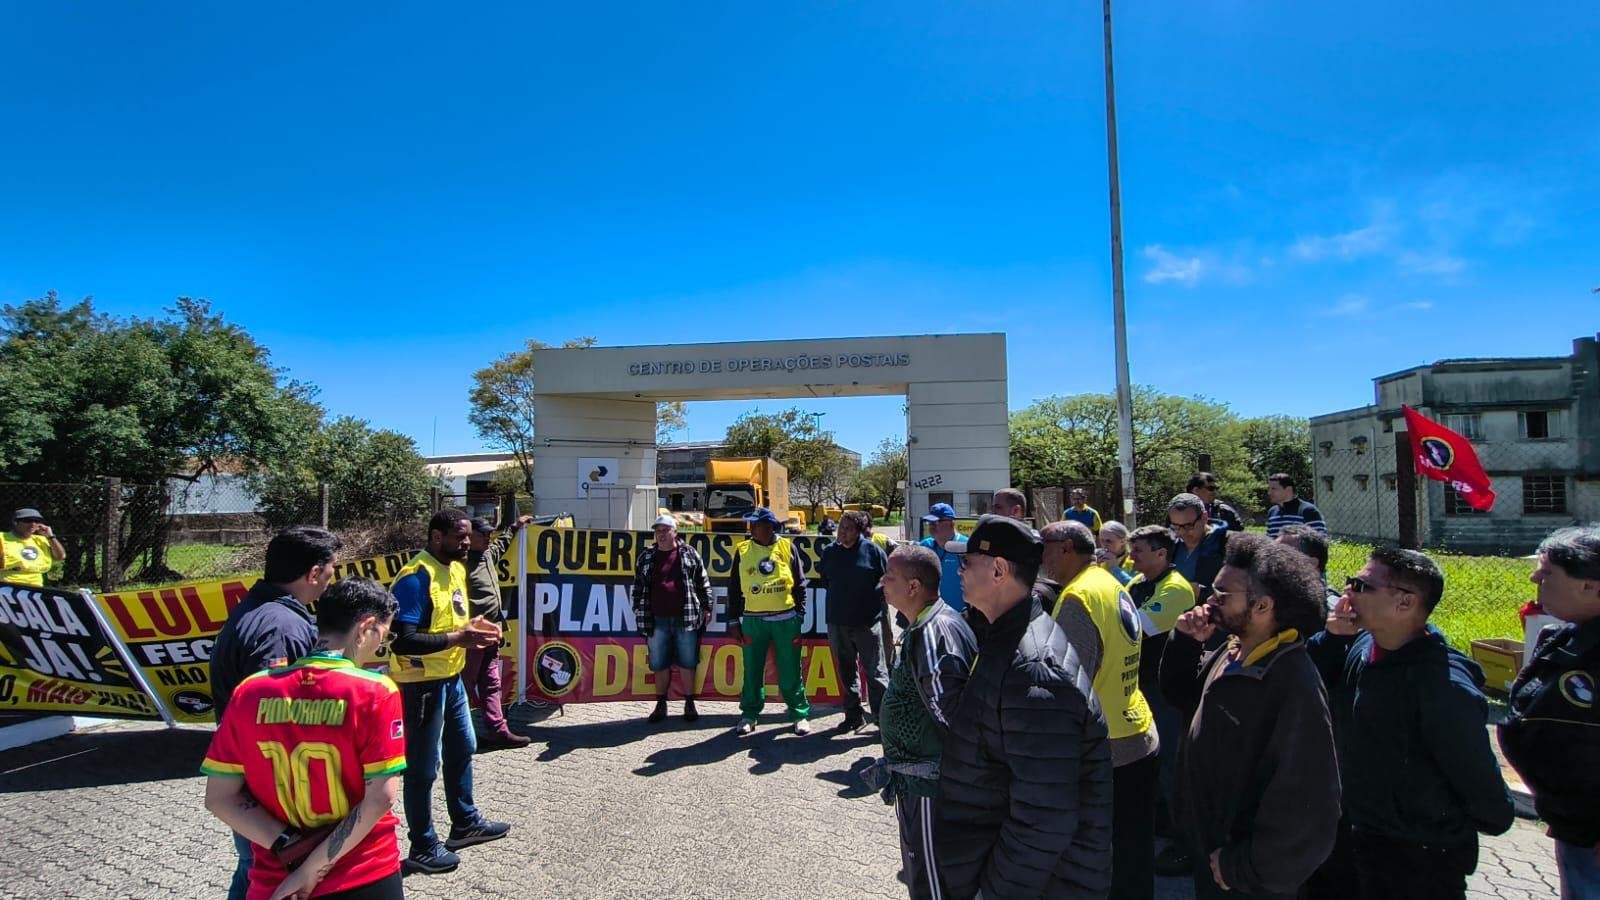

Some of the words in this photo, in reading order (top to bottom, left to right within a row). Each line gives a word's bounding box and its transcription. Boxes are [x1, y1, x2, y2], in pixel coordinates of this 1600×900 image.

[628, 360, 695, 376] CENTRO
[699, 359, 722, 373] DE
[727, 353, 832, 373] OPERAÇÕES
[837, 353, 911, 368] POSTAIS
[914, 474, 943, 490] 4222
[537, 529, 733, 575] QUEREOS
[534, 583, 638, 632] PLAN
[706, 586, 729, 633] E
[21, 632, 102, 682] JÁ!
[142, 639, 213, 665] FEC
[155, 664, 208, 686] NÃO
[593, 644, 656, 697] DE
[256, 741, 350, 829] 10
